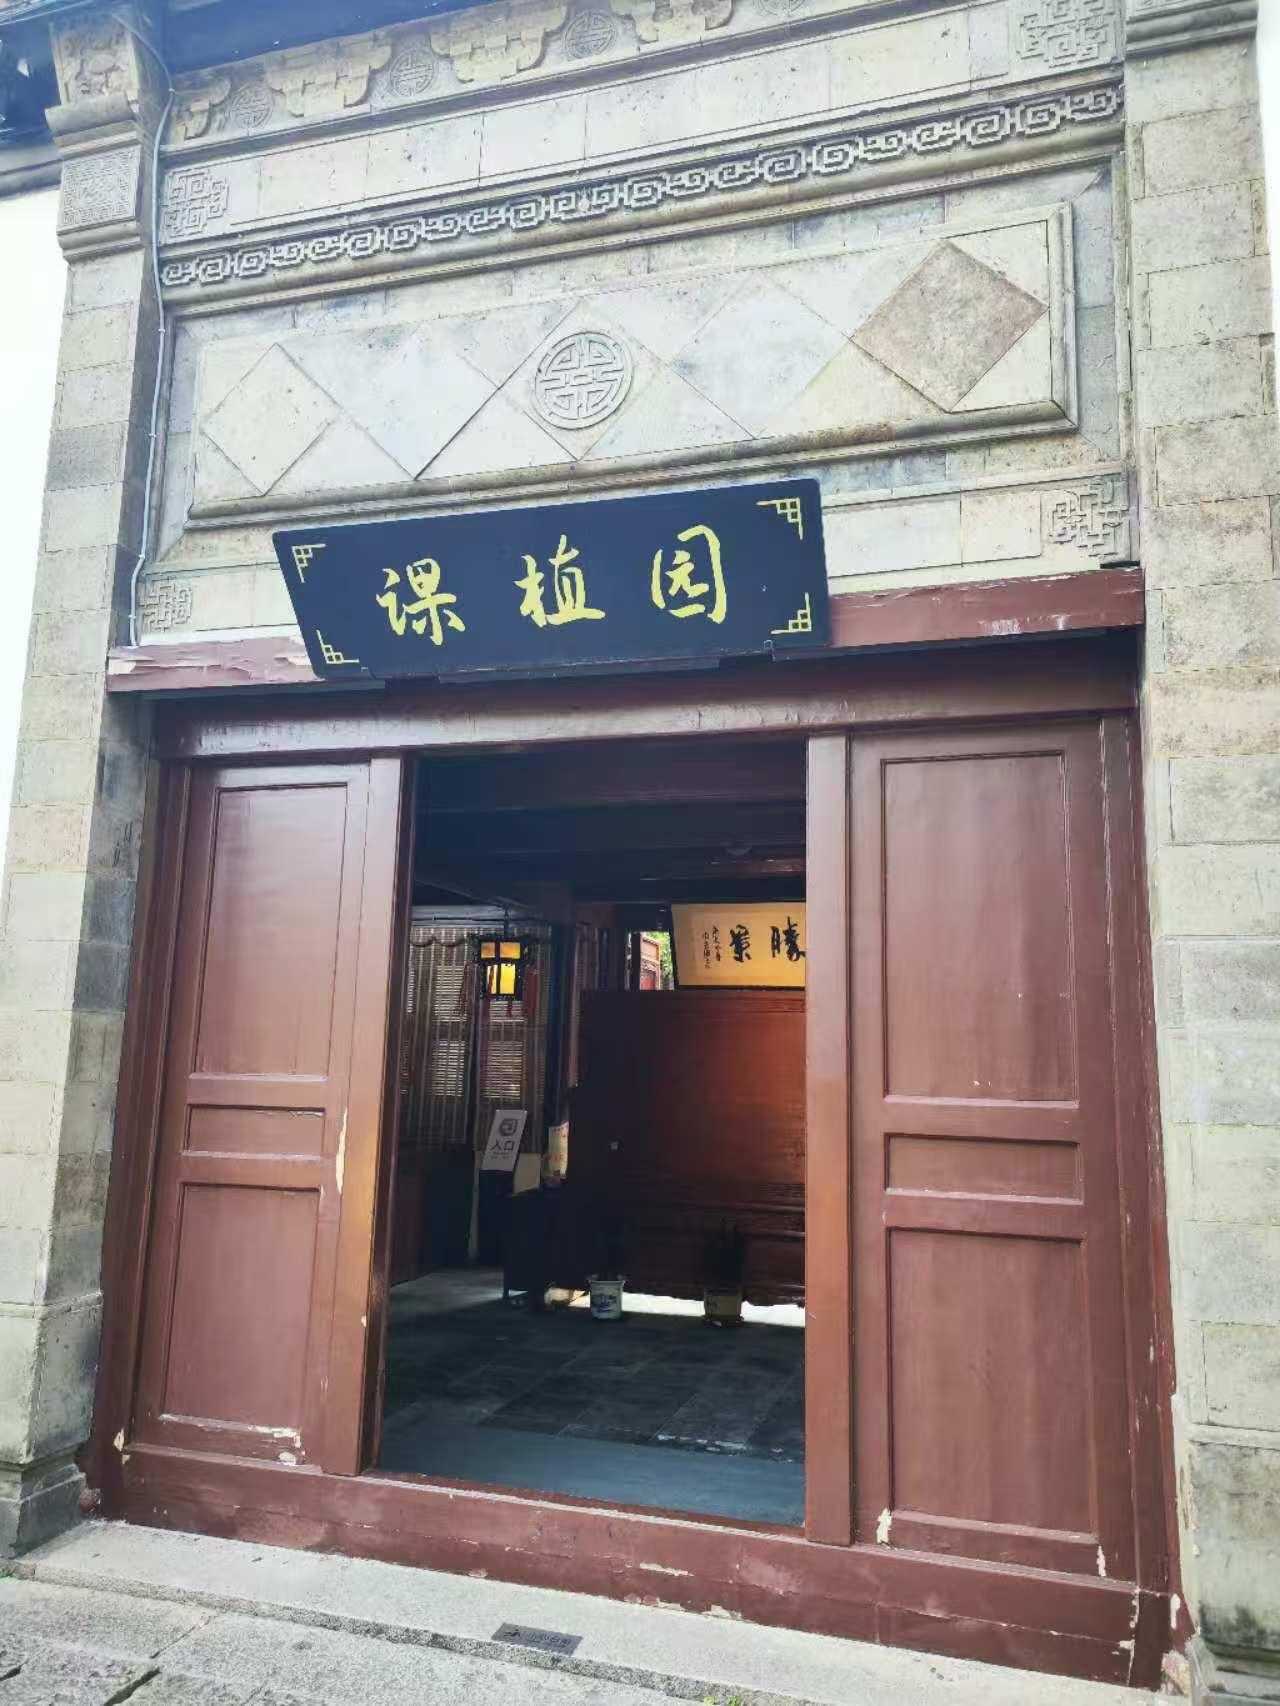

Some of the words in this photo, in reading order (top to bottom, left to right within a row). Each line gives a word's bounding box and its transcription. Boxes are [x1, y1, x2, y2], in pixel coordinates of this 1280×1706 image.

[376, 524, 728, 646] 课植园
[490, 1139, 515, 1151] 入口
